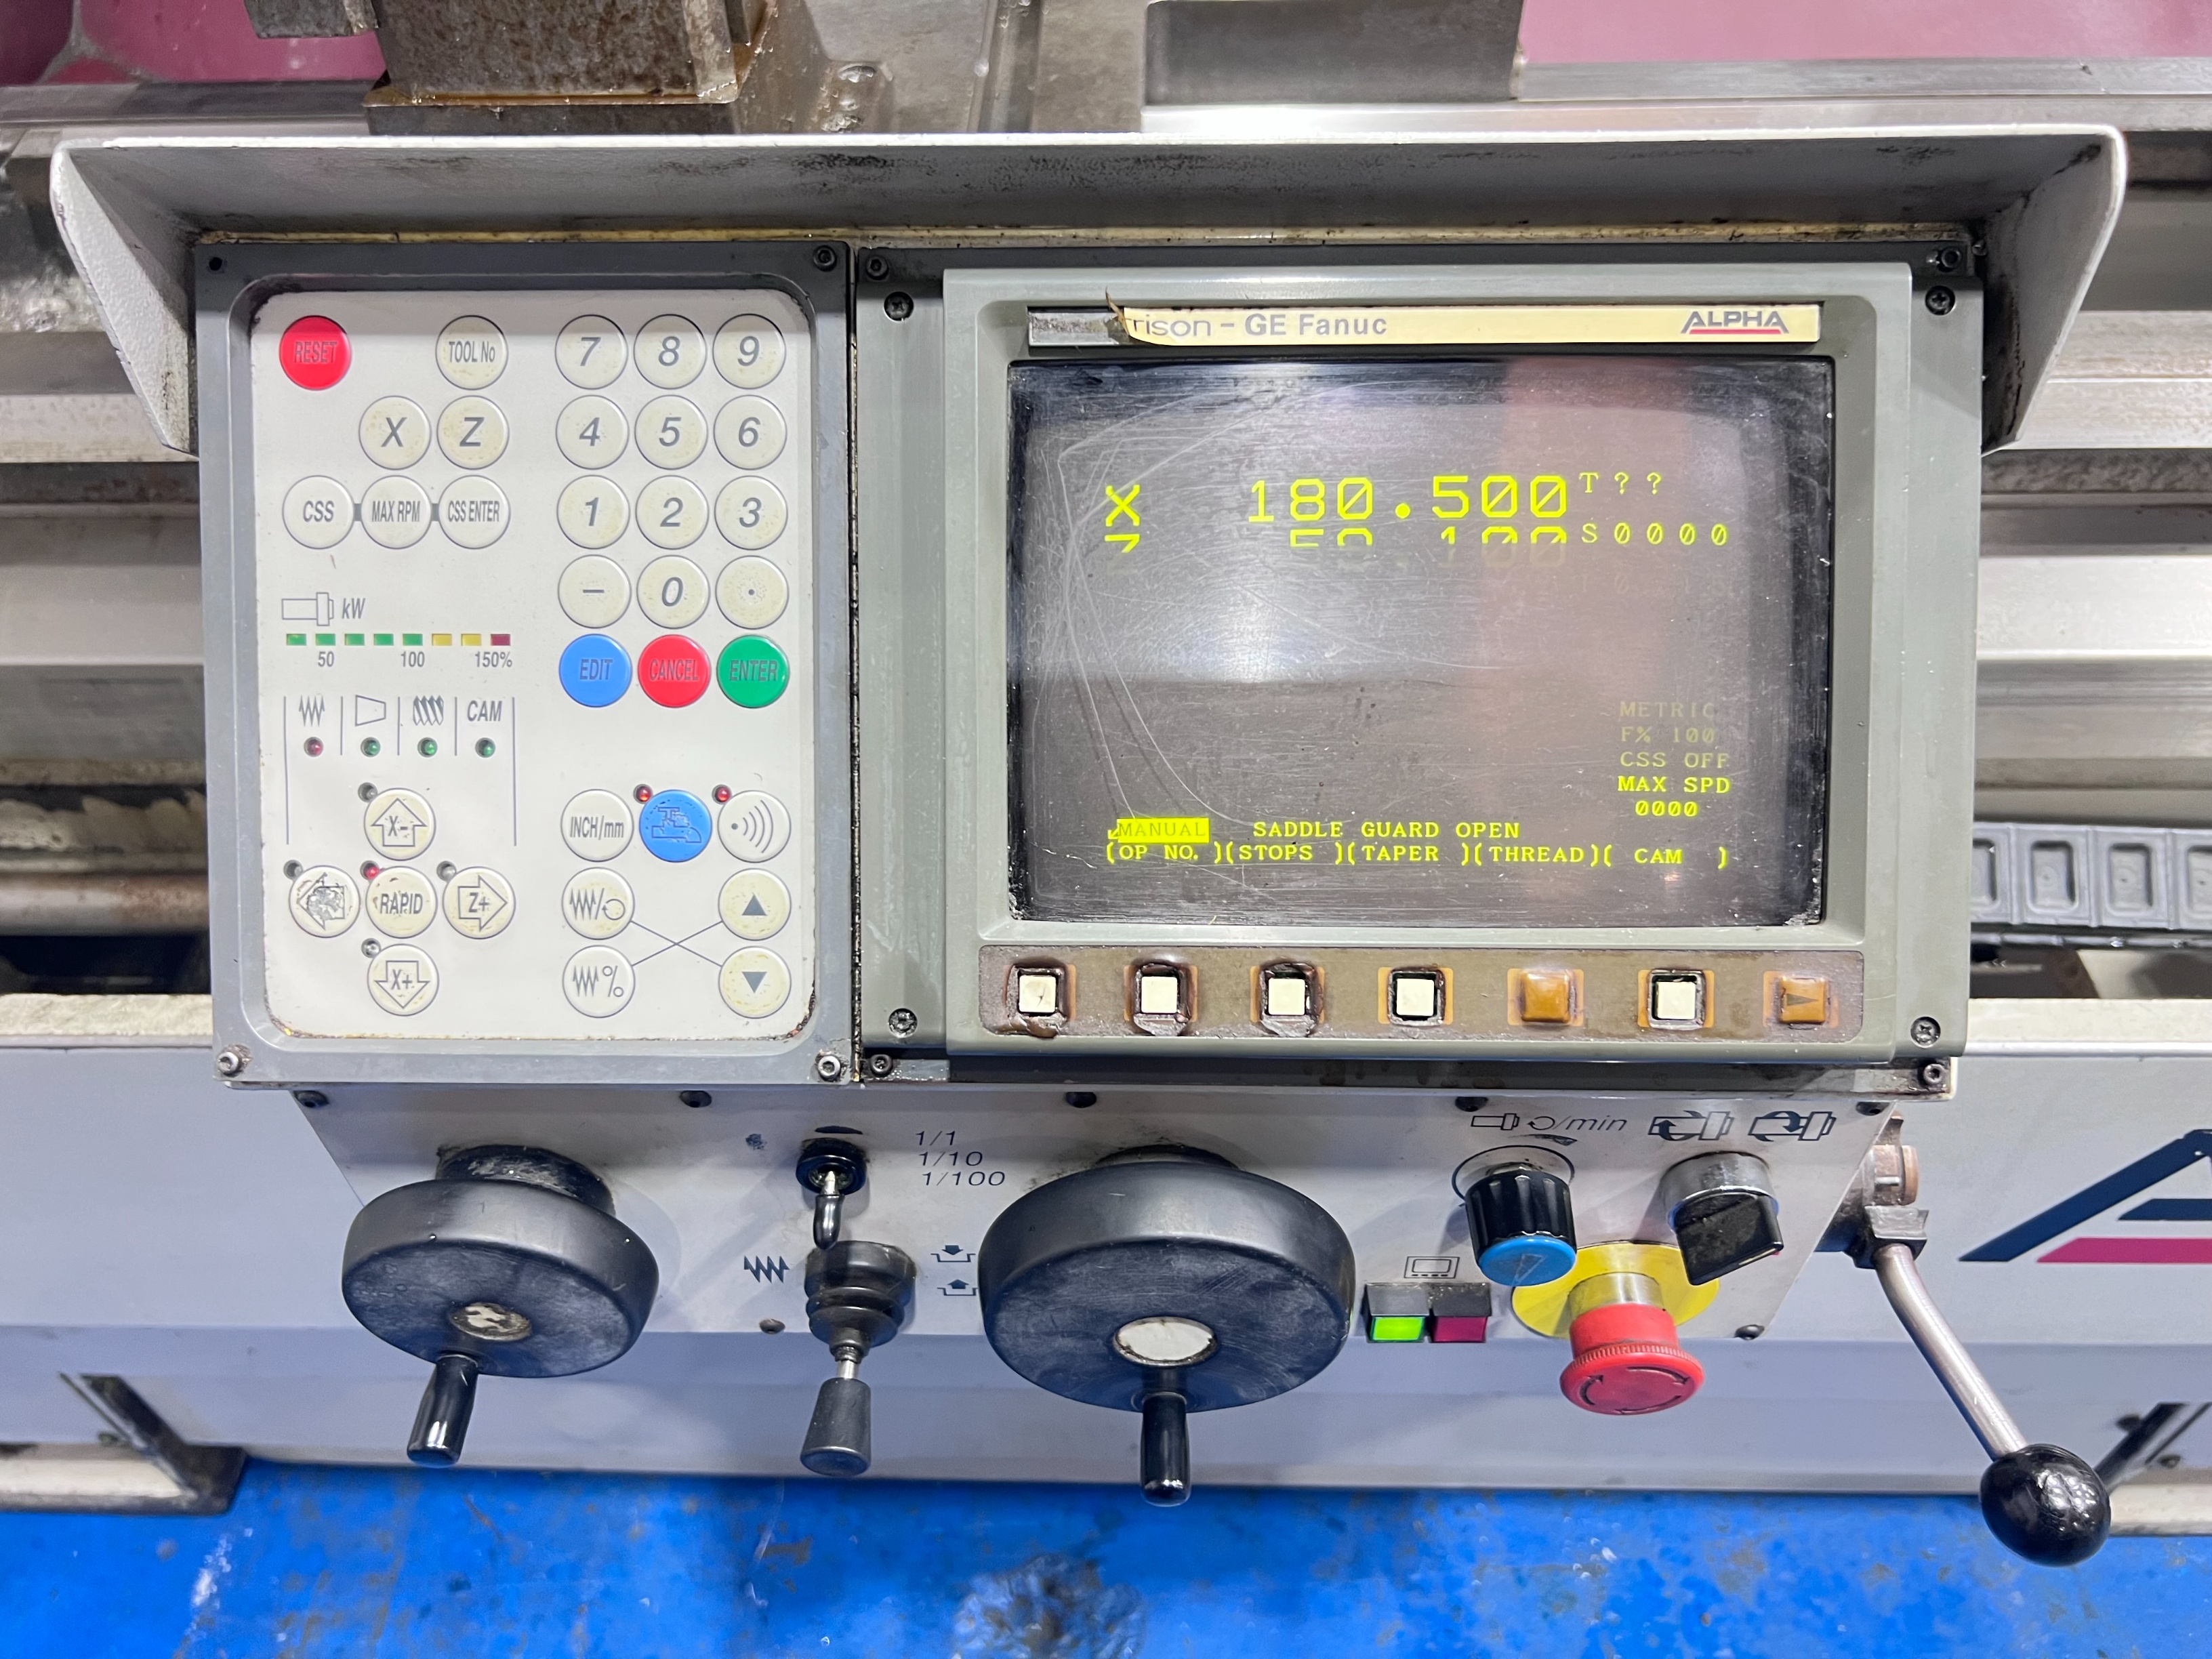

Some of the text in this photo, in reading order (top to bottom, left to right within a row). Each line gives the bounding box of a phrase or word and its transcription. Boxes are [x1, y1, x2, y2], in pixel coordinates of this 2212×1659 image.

[1126, 314, 1211, 337] rison
[1245, 314, 1287, 335] GE
[1299, 314, 1387, 335] Fanuc
[1681, 311, 1789, 334] ALPHA
[294, 342, 337, 363] RESET
[449, 341, 495, 363] TOOL No
[580, 337, 602, 367] 7
[658, 335, 681, 367] 8
[737, 335, 760, 367] 9
[380, 417, 407, 447] X
[459, 417, 485, 447] Z
[579, 417, 600, 447] 4
[659, 417, 682, 447] 5
[738, 417, 761, 447] 6
[303, 500, 335, 523] CSS
[371, 501, 420, 523] MAX RPM
[447, 500, 500, 523] CSS ENTER
[585, 497, 600, 527] 1
[660, 497, 684, 527] 2
[1105, 474, 1568, 527] X 180.500
[739, 497, 762, 528] 3
[661, 577, 683, 607] 0
[342, 598, 365, 619] kW
[317, 651, 513, 668] 50 100 150%
[579, 659, 613, 680] EDIT
[649, 659, 699, 681] CANCEL
[729, 659, 778, 682] ENTER
[467, 700, 502, 722] CAM
[1620, 701, 1715, 718] METRIC
[1620, 726, 1715, 743] F% 100
[1620, 752, 1729, 768] CSS OFF
[1618, 775, 1730, 793] MAX SPD
[1635, 800, 1698, 817] 0000
[569, 815, 624, 840] INCH/mm
[1118, 822, 1520, 838] MANUAL SADDLE GUARD OPEN
[378, 893, 423, 915] RAPID
[915, 1130, 957, 1146] 1/1
[918, 1151, 983, 1166] 1/10
[922, 1171, 1006, 1187] 1/100
